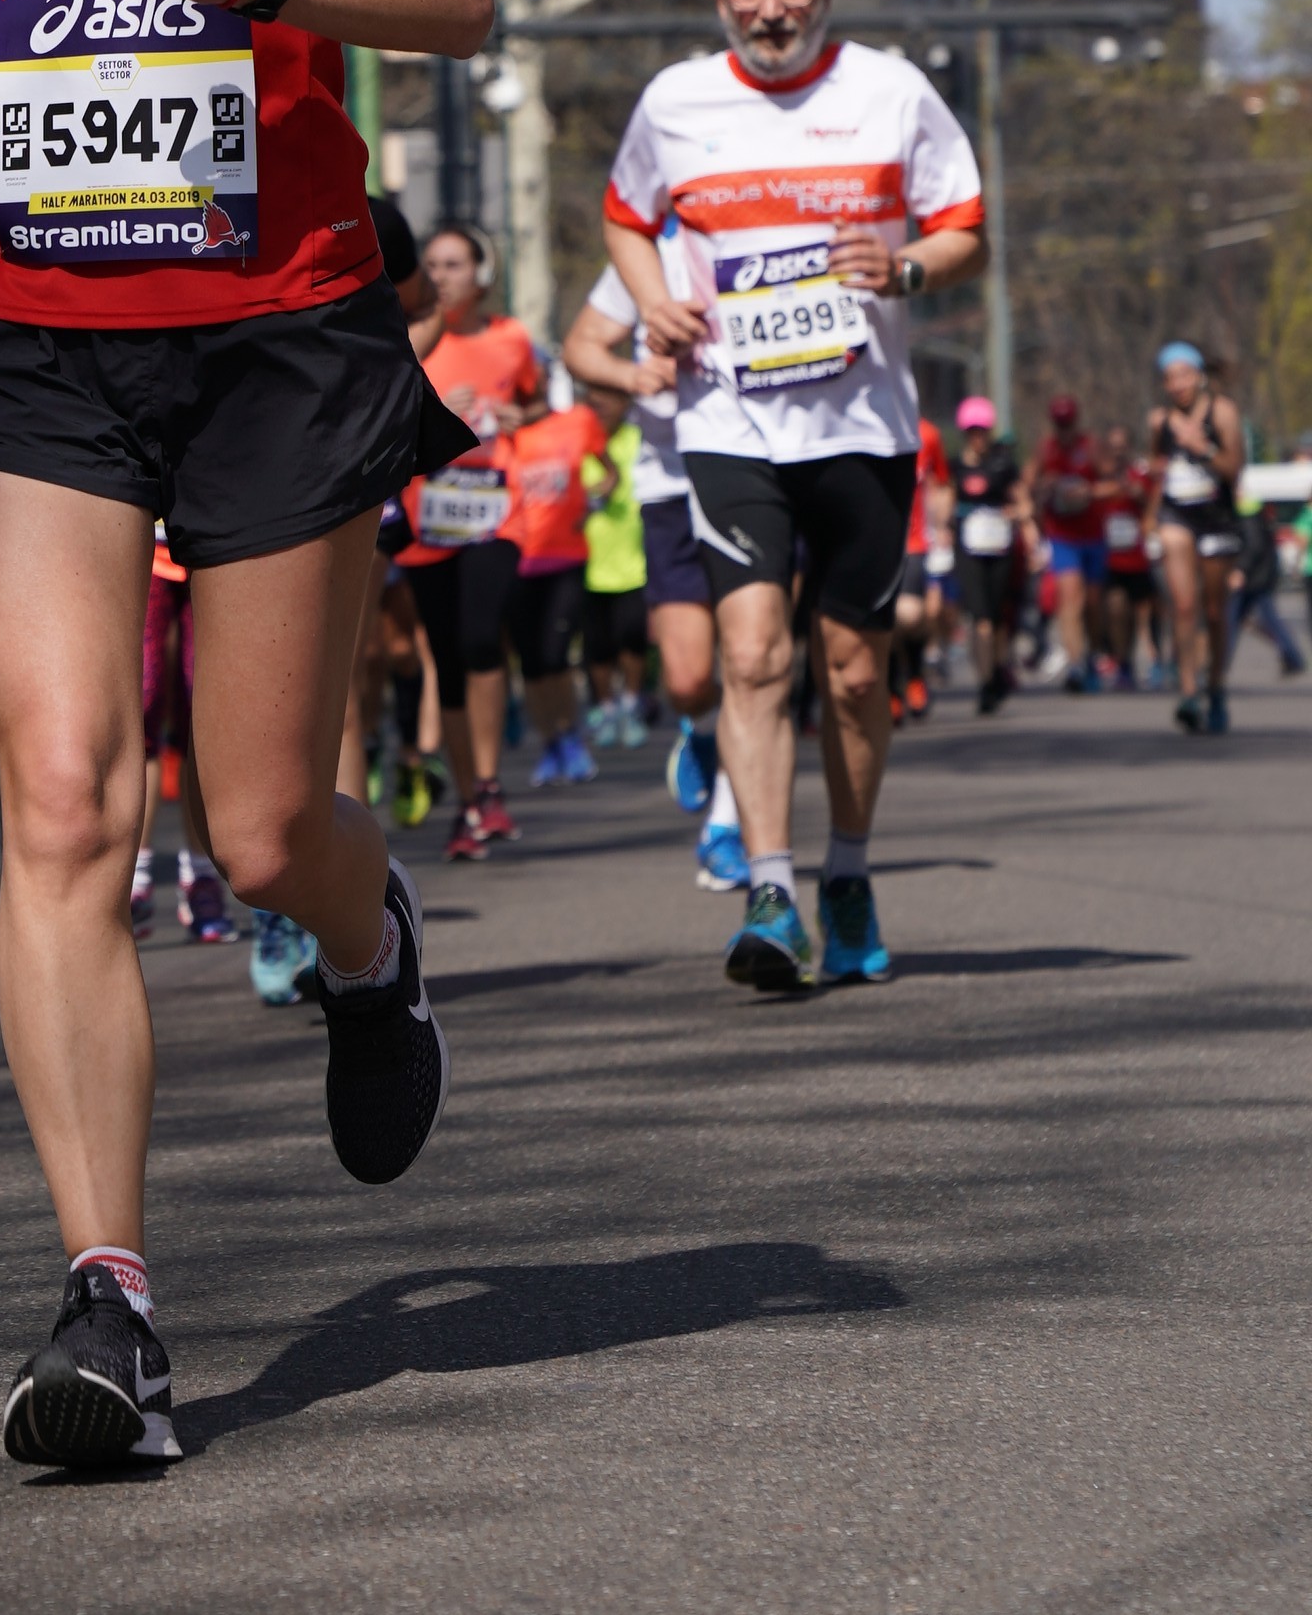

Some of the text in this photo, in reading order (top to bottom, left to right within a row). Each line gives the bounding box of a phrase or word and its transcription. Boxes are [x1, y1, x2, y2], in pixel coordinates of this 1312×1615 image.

[97, 59, 134, 70] SETTORE
[99, 70, 131, 80] SECTOR
[41, 96, 200, 168] 5947
[41, 190, 201, 209] HALF MARATHON 24.03.2019
[9, 219, 205, 251] Stramilano
[751, 301, 835, 344] 4299
